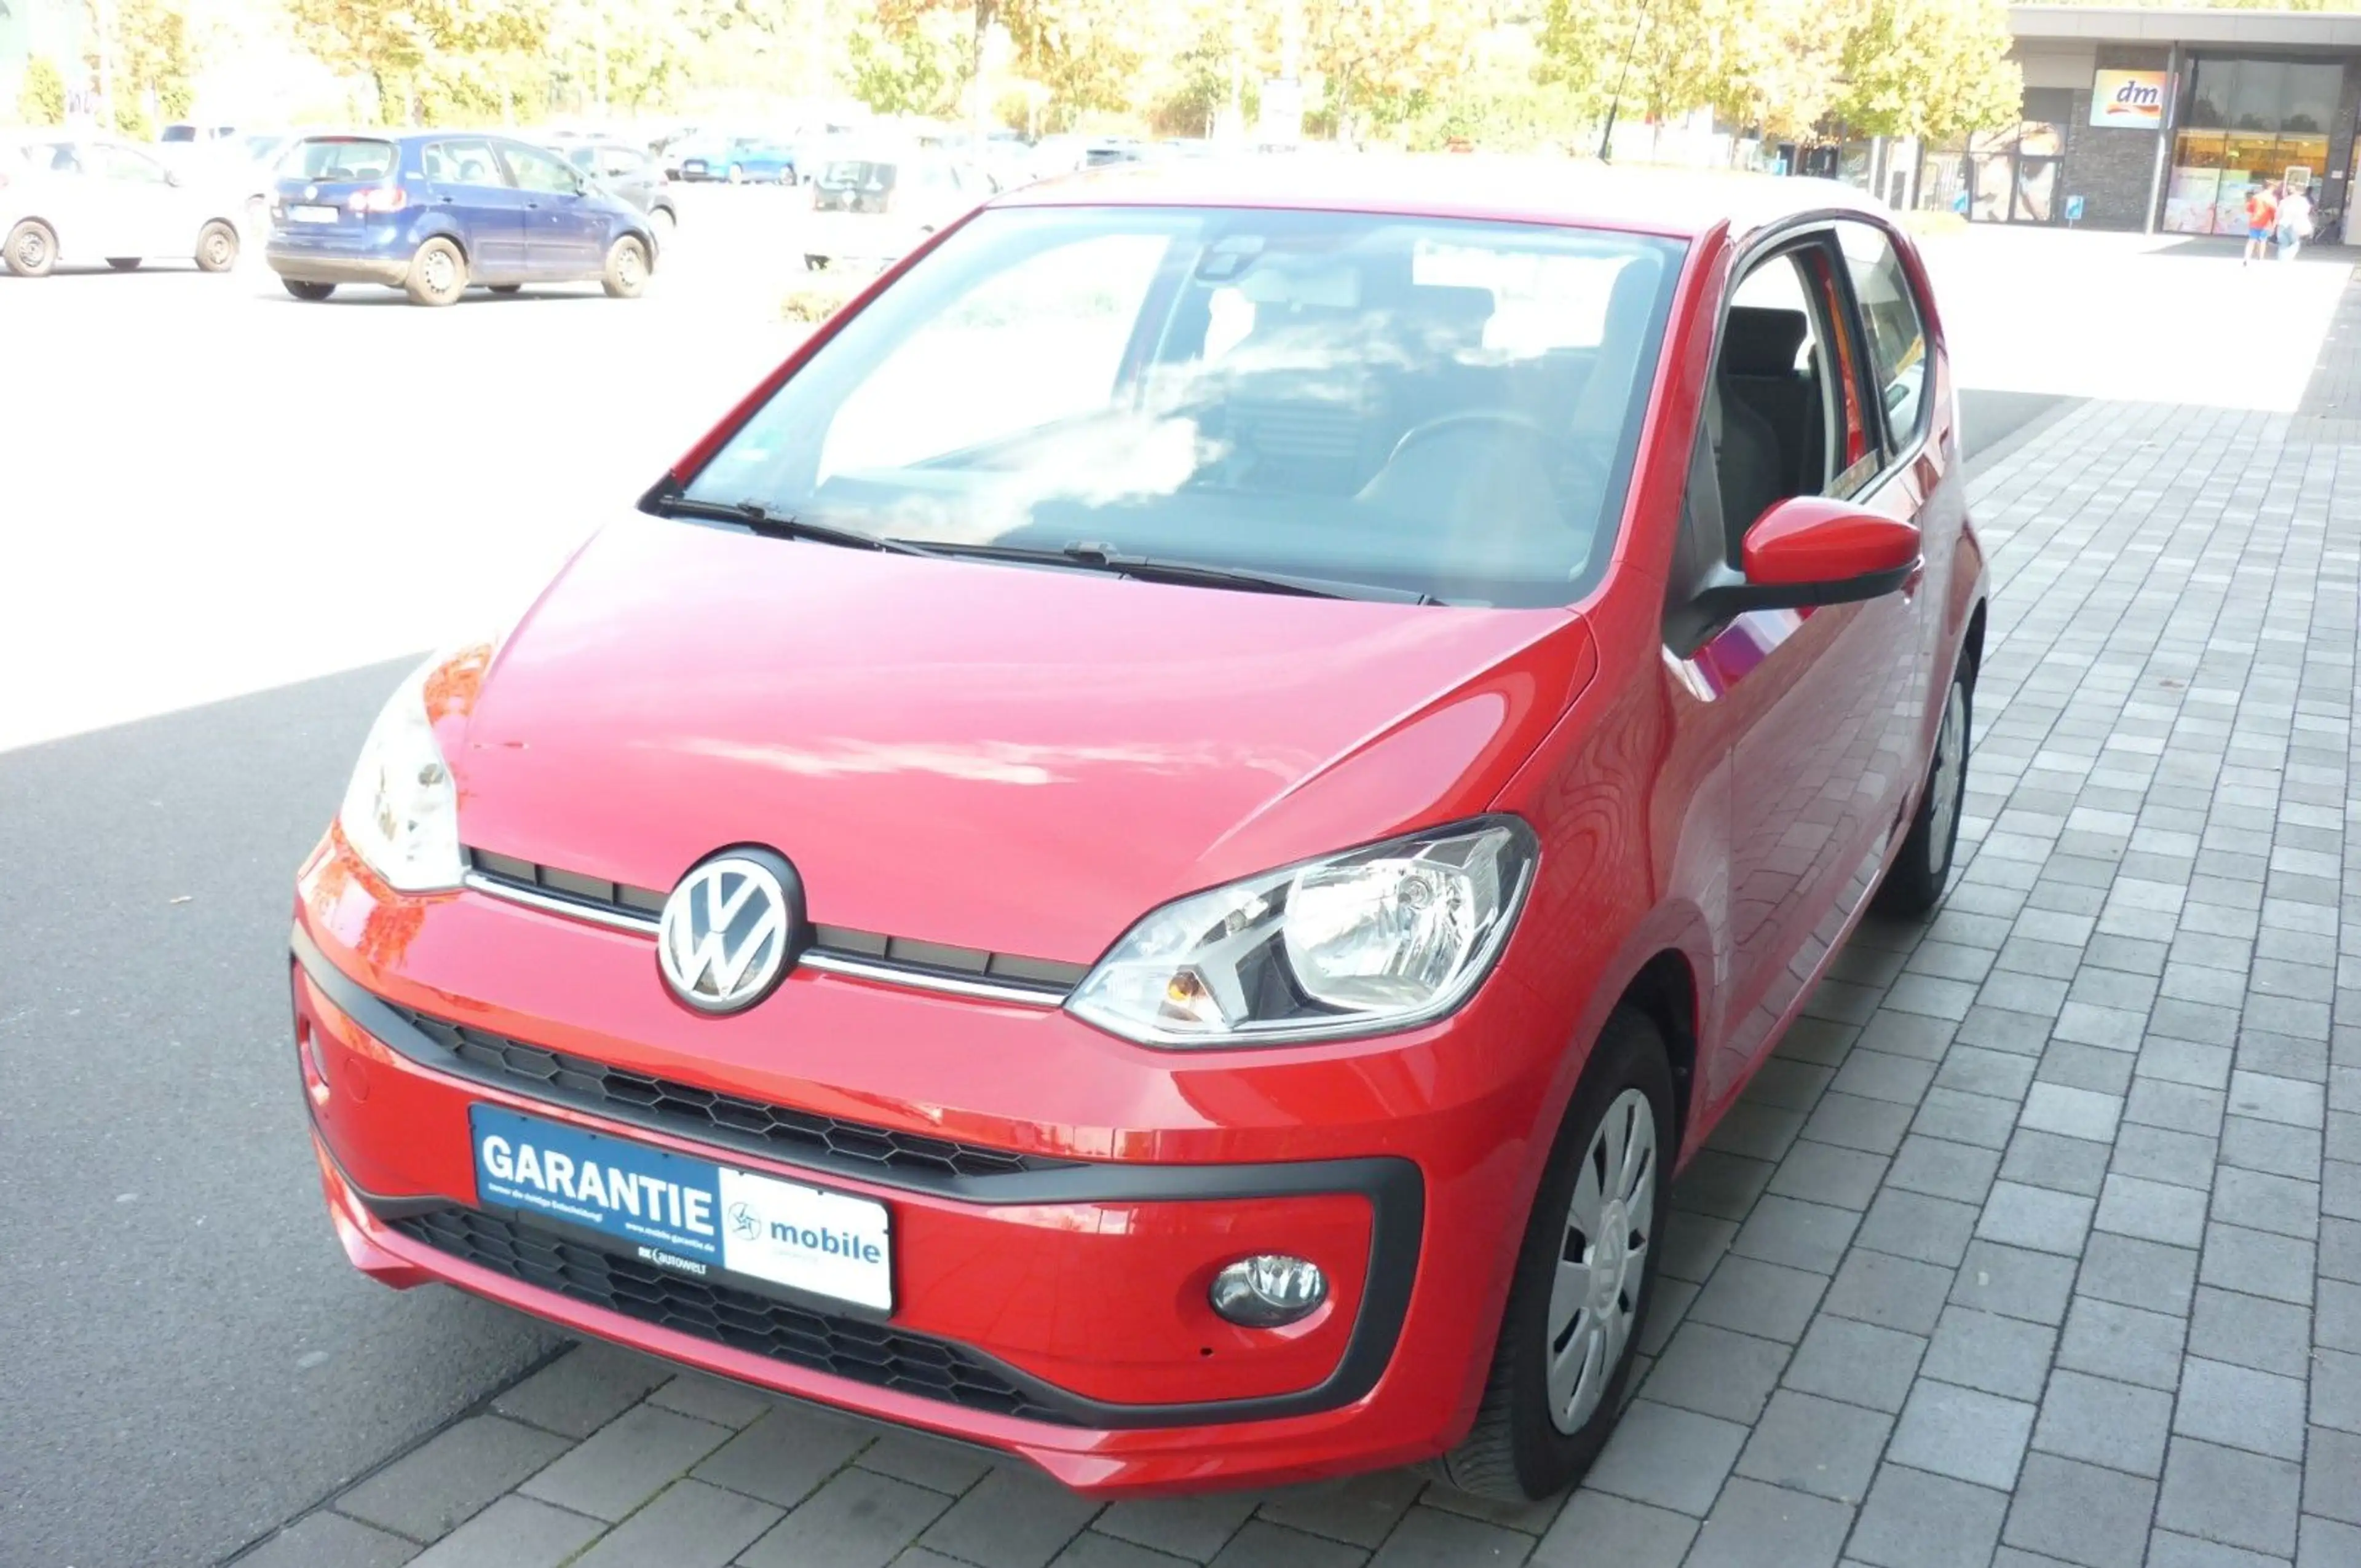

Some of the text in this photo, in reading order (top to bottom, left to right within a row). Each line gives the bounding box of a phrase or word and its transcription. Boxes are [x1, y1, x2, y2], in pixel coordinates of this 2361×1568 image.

[2116, 80, 2157, 103] dm
[482, 1135, 715, 1236] GARANTIE
[770, 1221, 881, 1264] mobile
